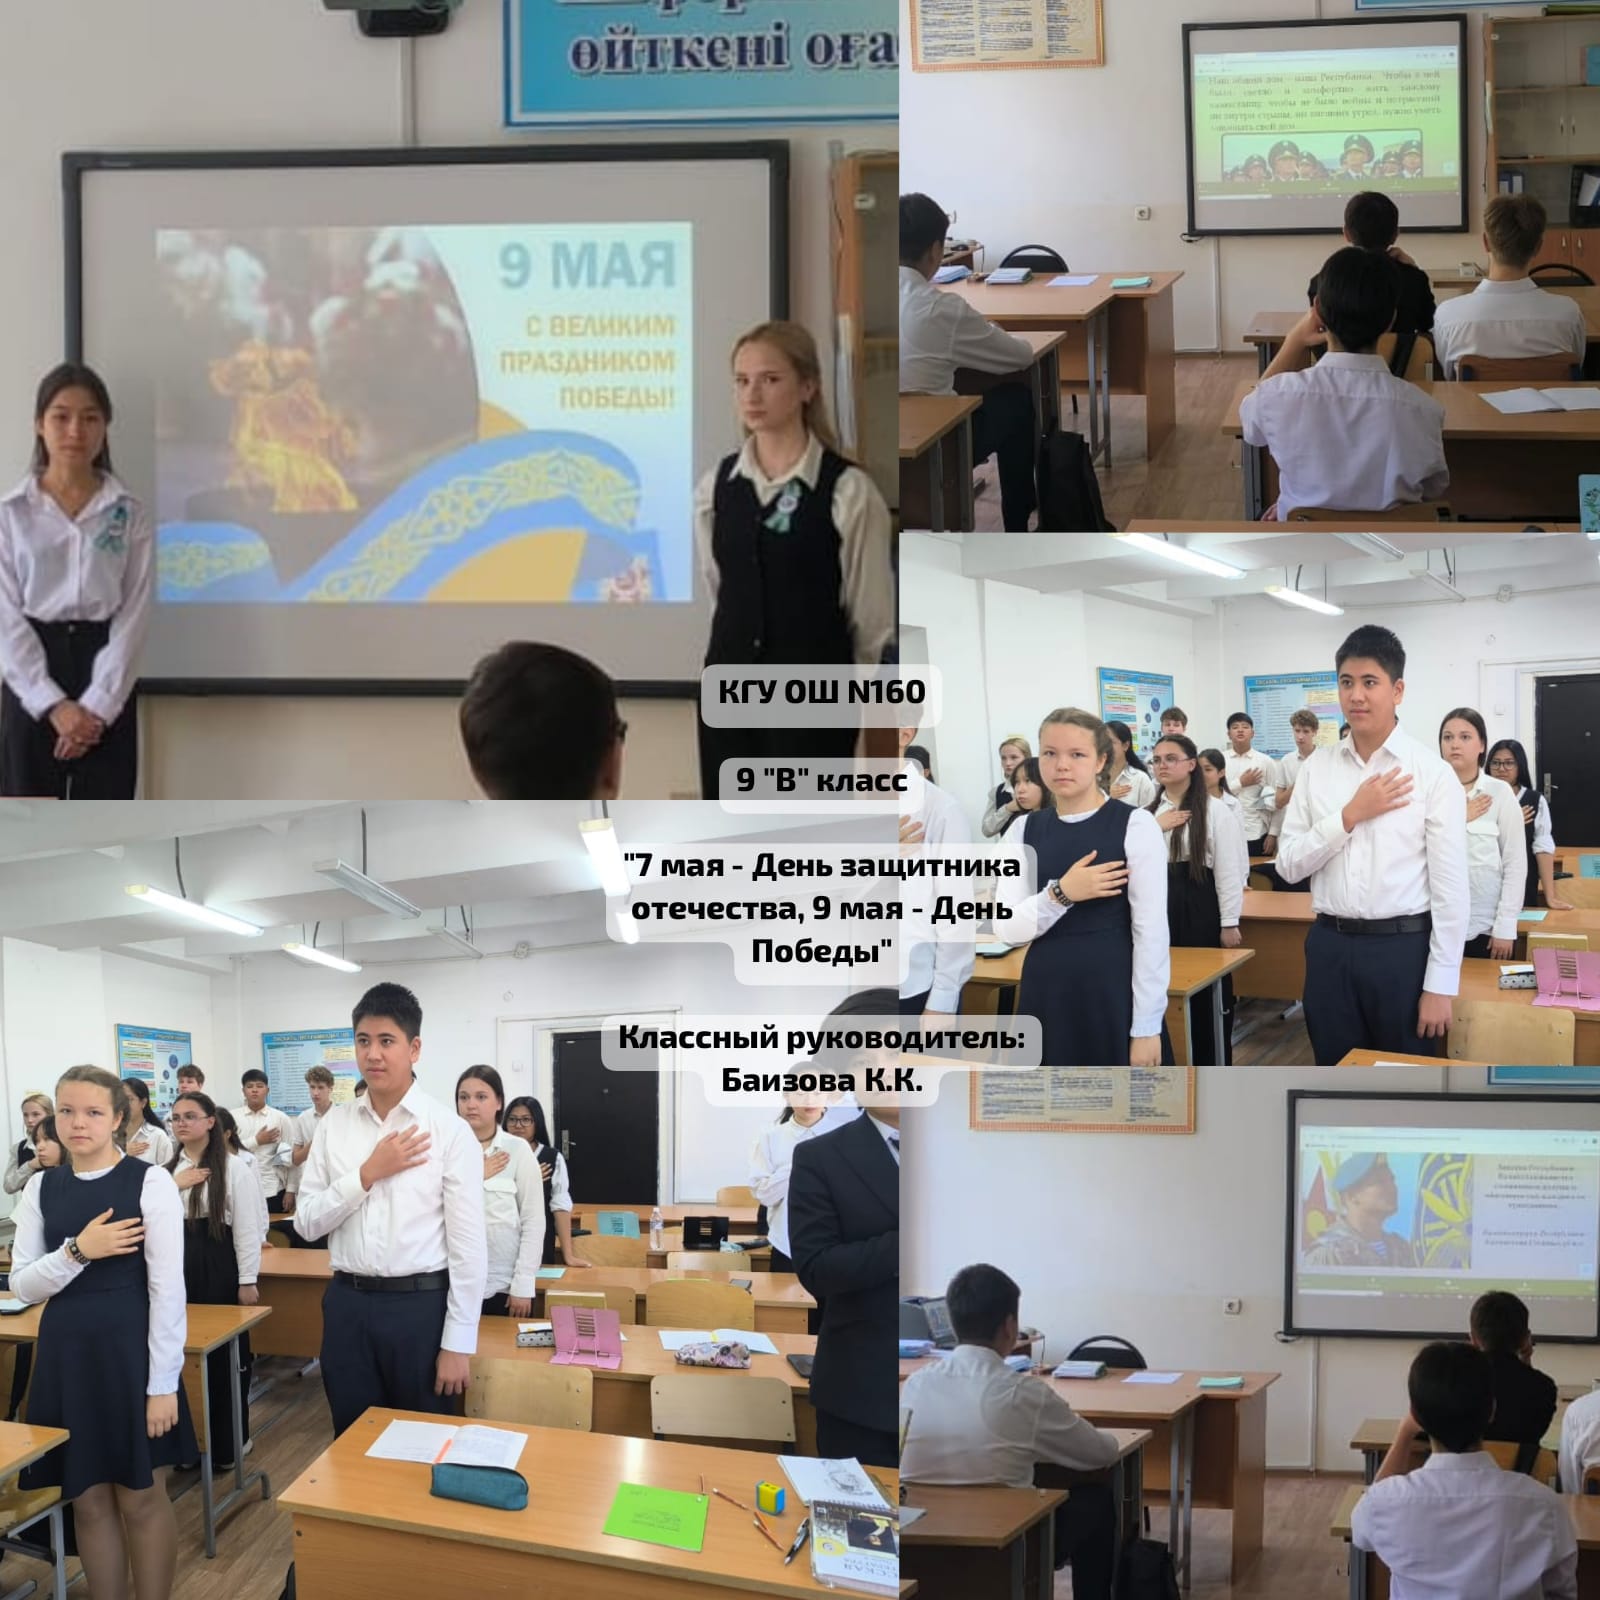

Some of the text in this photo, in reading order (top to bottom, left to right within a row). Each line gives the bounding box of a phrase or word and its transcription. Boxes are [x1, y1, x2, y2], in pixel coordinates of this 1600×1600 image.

[569, 21, 789, 73] өйткені
[805, 31, 899, 66] оға
[500, 241, 676, 289] 9 МАЯ
[527, 315, 675, 336] С ВЕЛИКИМ
[500, 350, 675, 375] ПРАЗДНИКОМ
[560, 385, 675, 408] ПОБЕДЫ!
